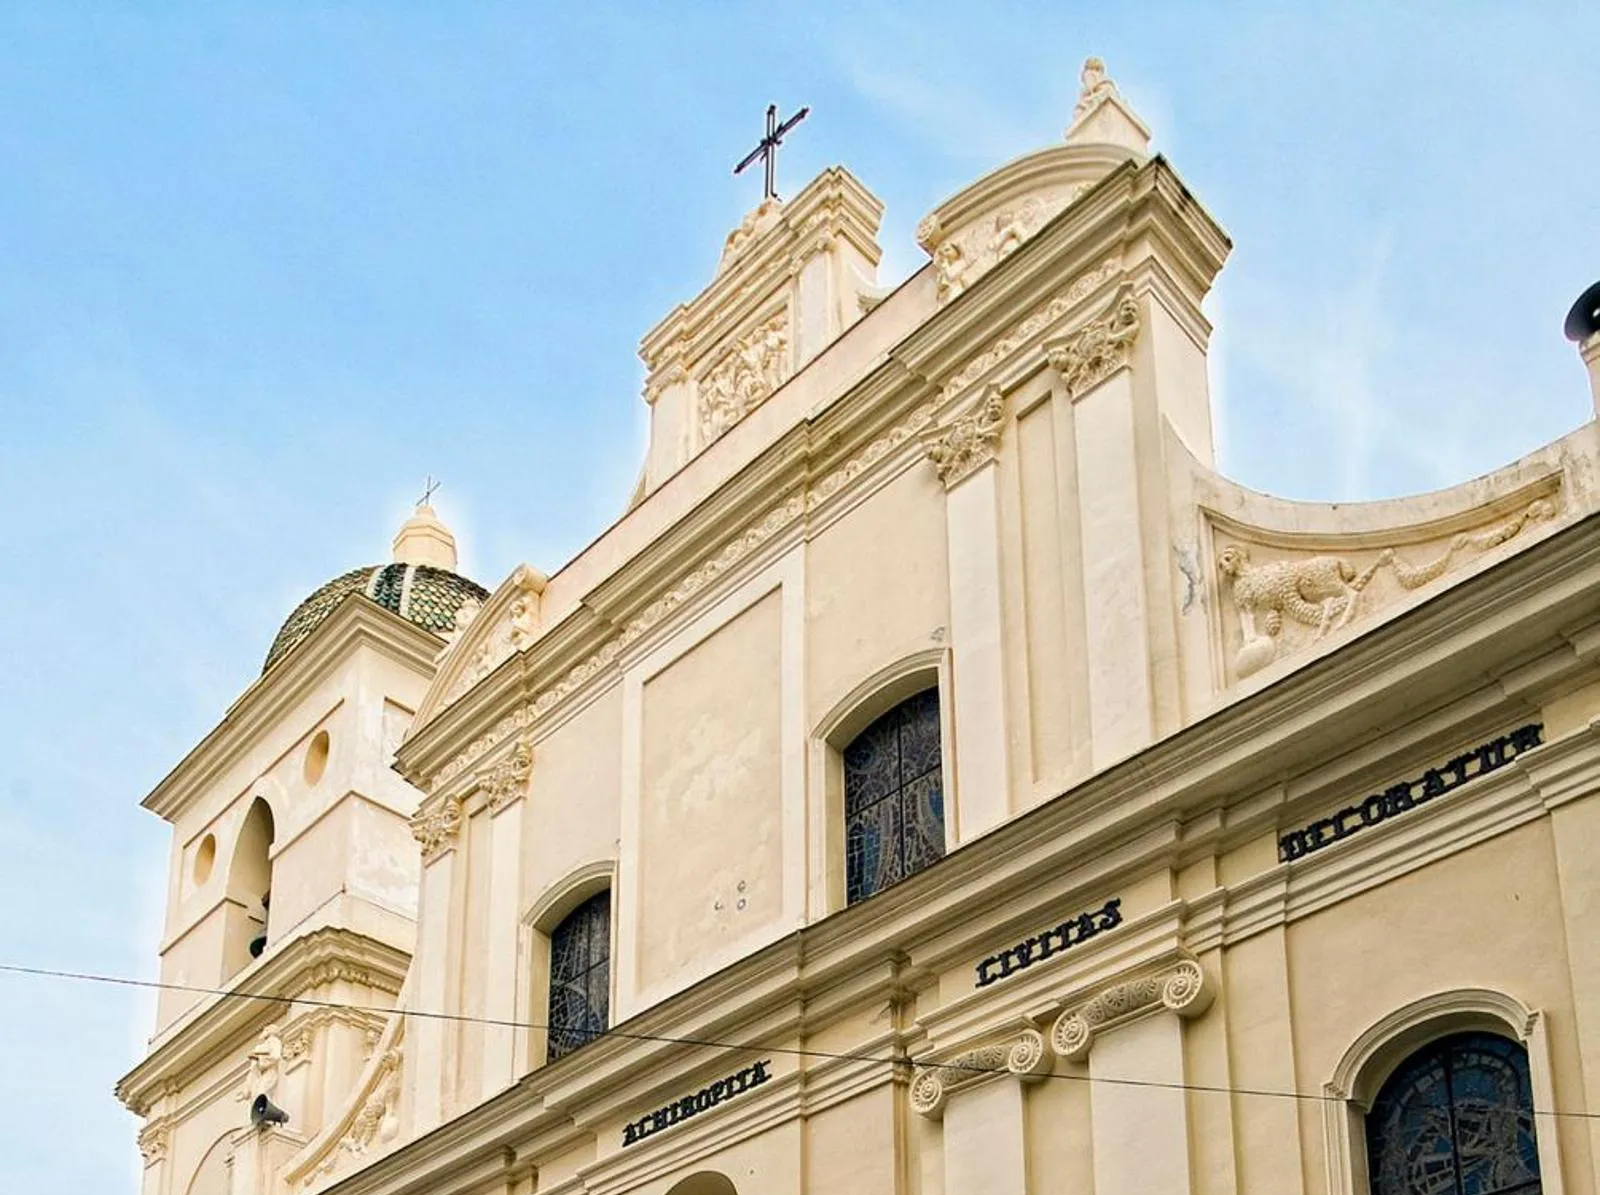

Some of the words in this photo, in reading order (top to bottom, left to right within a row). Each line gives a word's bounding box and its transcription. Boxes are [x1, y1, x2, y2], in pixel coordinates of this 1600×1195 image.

[621, 1058, 773, 1148] ACHIROPITA
[974, 897, 1124, 989] CIVITAS
[1279, 722, 1544, 863] DECORATUR
